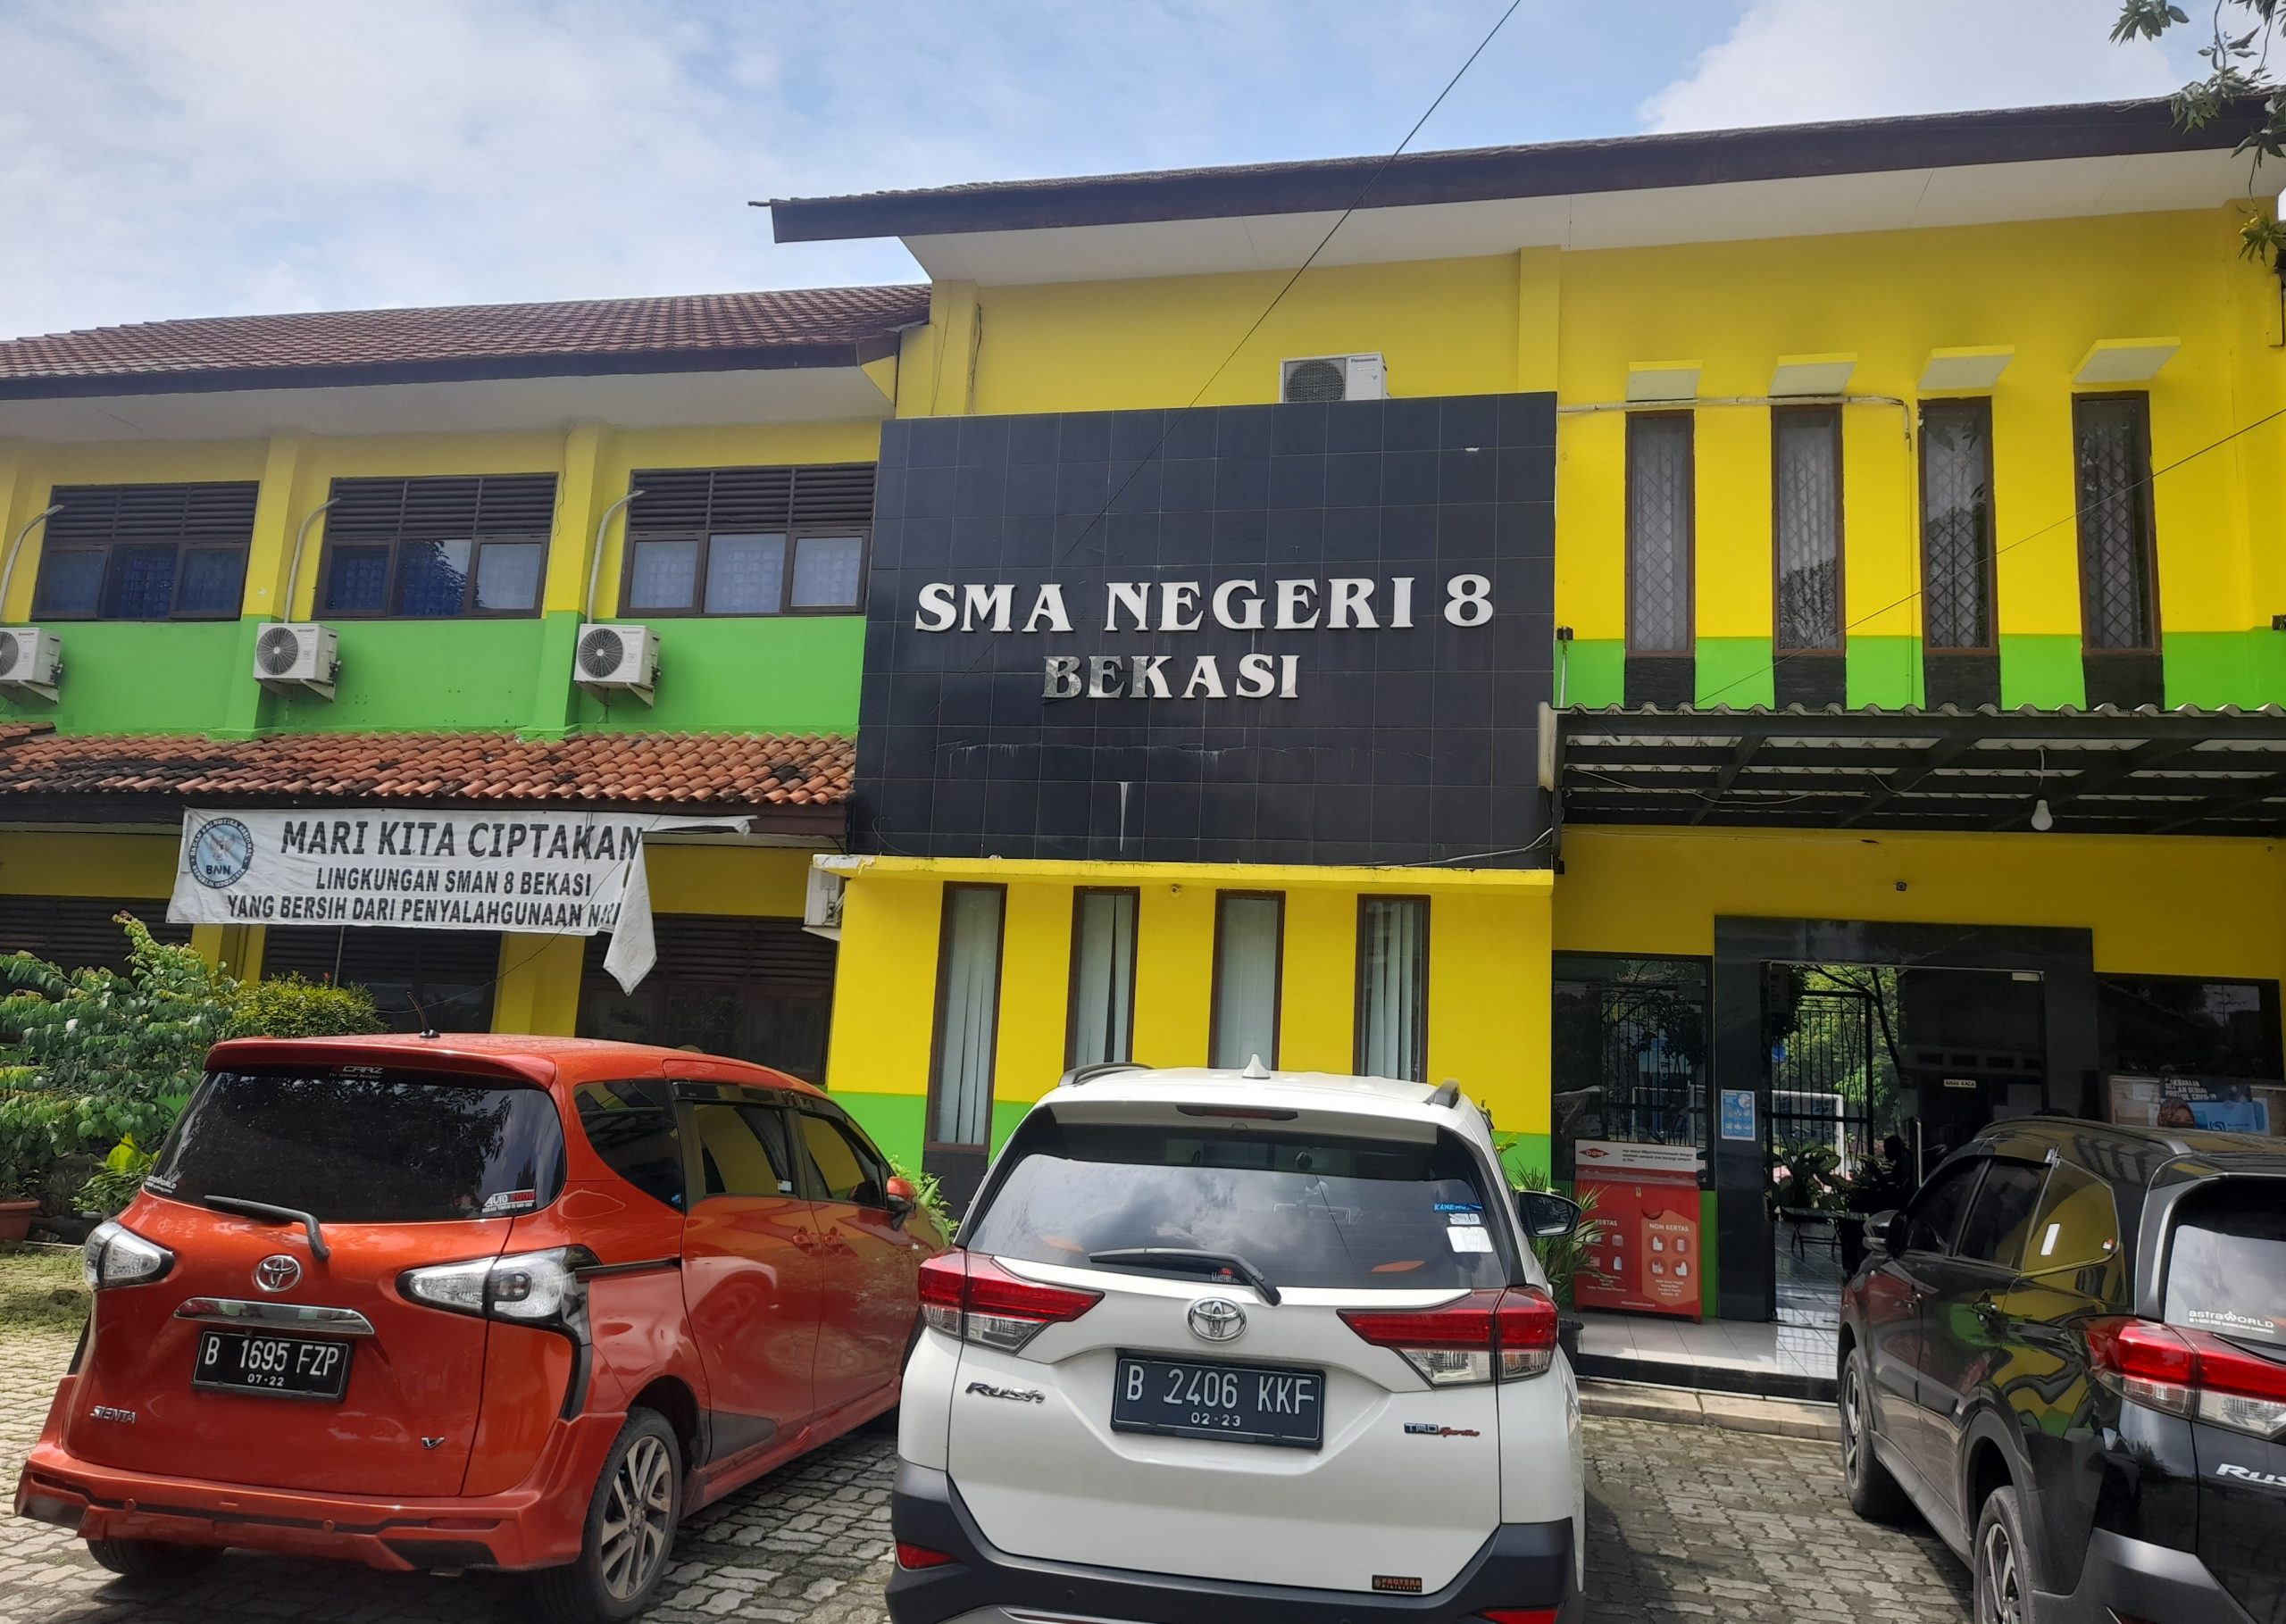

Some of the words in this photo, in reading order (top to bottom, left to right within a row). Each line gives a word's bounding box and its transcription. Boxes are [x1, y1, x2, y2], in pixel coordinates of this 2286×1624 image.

[914, 582, 1073, 632] SMA
[1104, 577, 1415, 631] NEGERI
[1443, 573, 1494, 627] 8
[1041, 653, 1300, 699] BEKASI
[280, 820, 368, 854] MARI
[378, 821, 455, 856] KITA
[468, 822, 643, 860] CIPTAKAN
[205, 864, 231, 875] BNN
[316, 867, 439, 892] LINGKUNGAN
[445, 870, 498, 893] SMAN
[504, 870, 514, 894] 8
[520, 871, 592, 896] BEKASI
[227, 895, 274, 918] YANG
[279, 895, 347, 919] BERSIH
[352, 897, 396, 920] DARI
[401, 898, 582, 927] PENYALAHGUNAAN
[484, 1195, 508, 1207] AUTO
[510, 1192, 535, 1202] 2000
[204, 1337, 221, 1365] B
[239, 1339, 291, 1371] 1695
[296, 1345, 339, 1377] FZP
[1126, 1365, 1144, 1401] B
[1163, 1369, 1239, 1409] 2406
[1257, 1375, 1314, 1414] KKF
[90, 1405, 136, 1424] SIENTA
[1405, 1423, 1438, 1434] TRD
